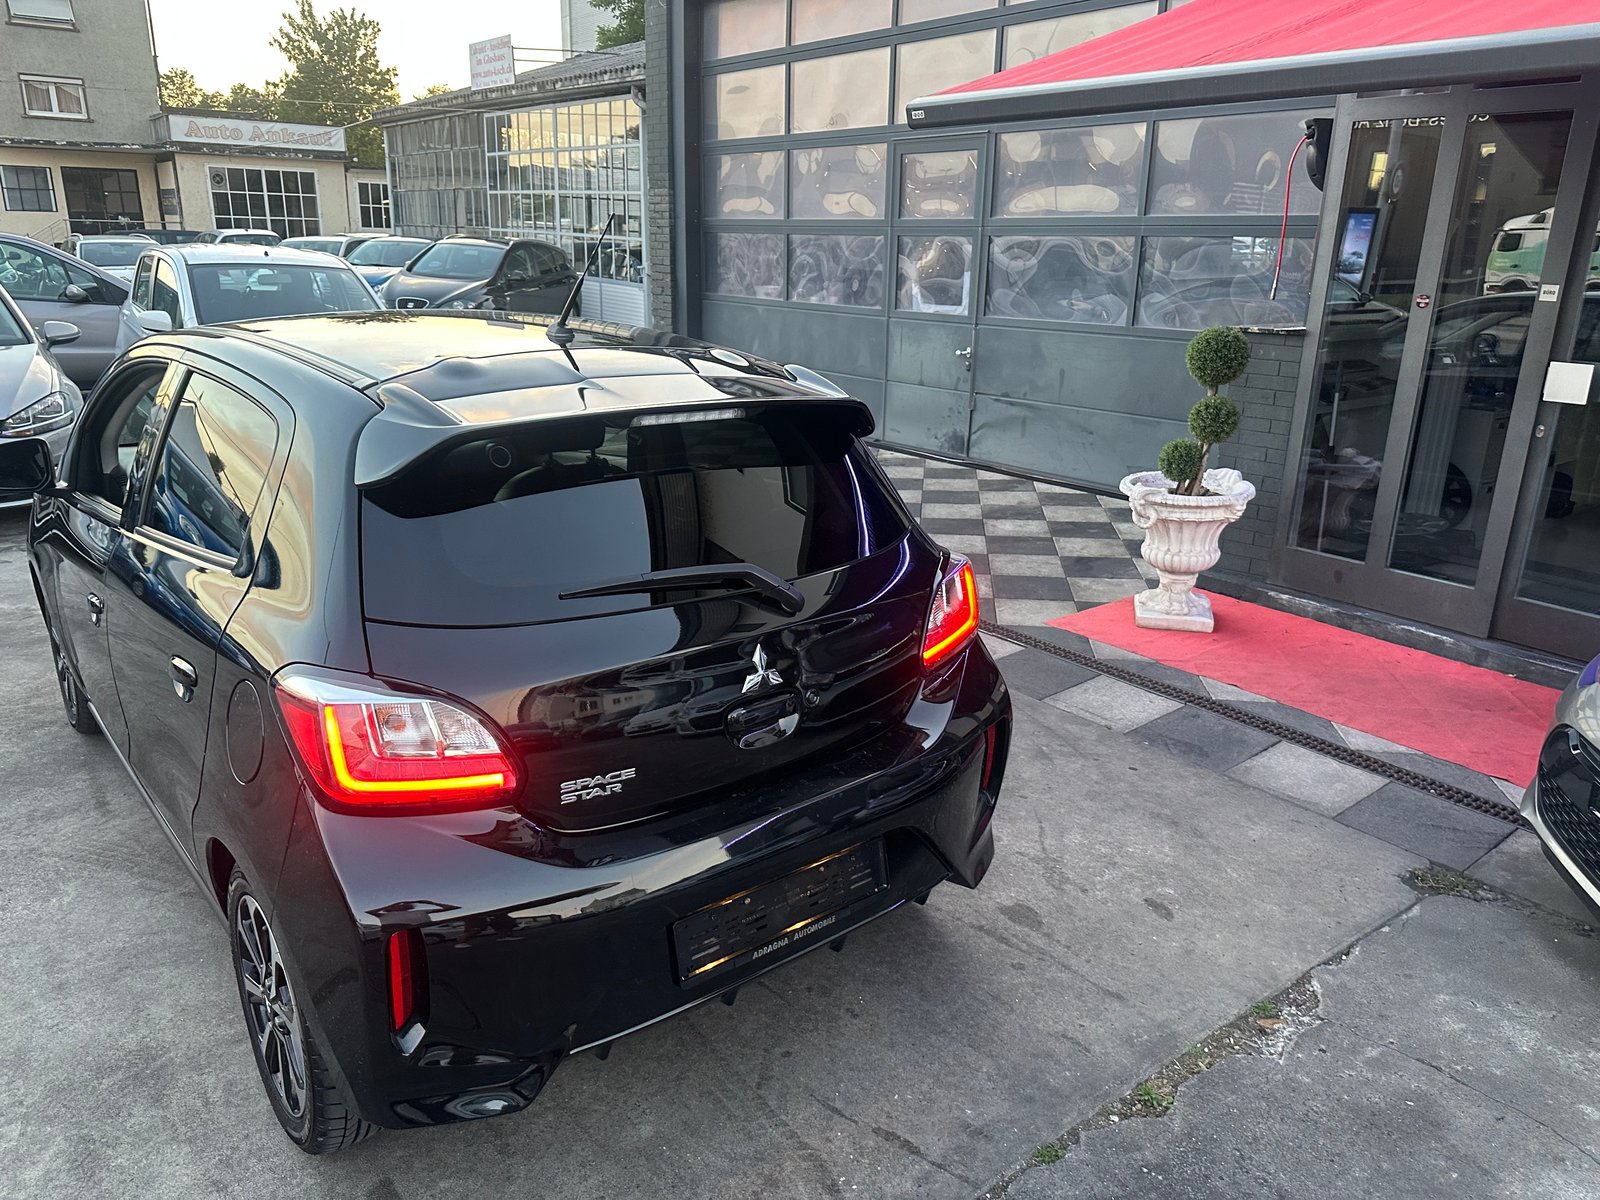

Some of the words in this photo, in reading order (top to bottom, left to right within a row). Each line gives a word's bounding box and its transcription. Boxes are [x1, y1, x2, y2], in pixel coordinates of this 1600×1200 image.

[185, 120, 243, 141] Auto
[560, 767, 636, 793] SPACE
[560, 783, 623, 805] STAR
[752, 937, 789, 960] ADRAGNA
[793, 915, 836, 941] AUTOMOBILE
